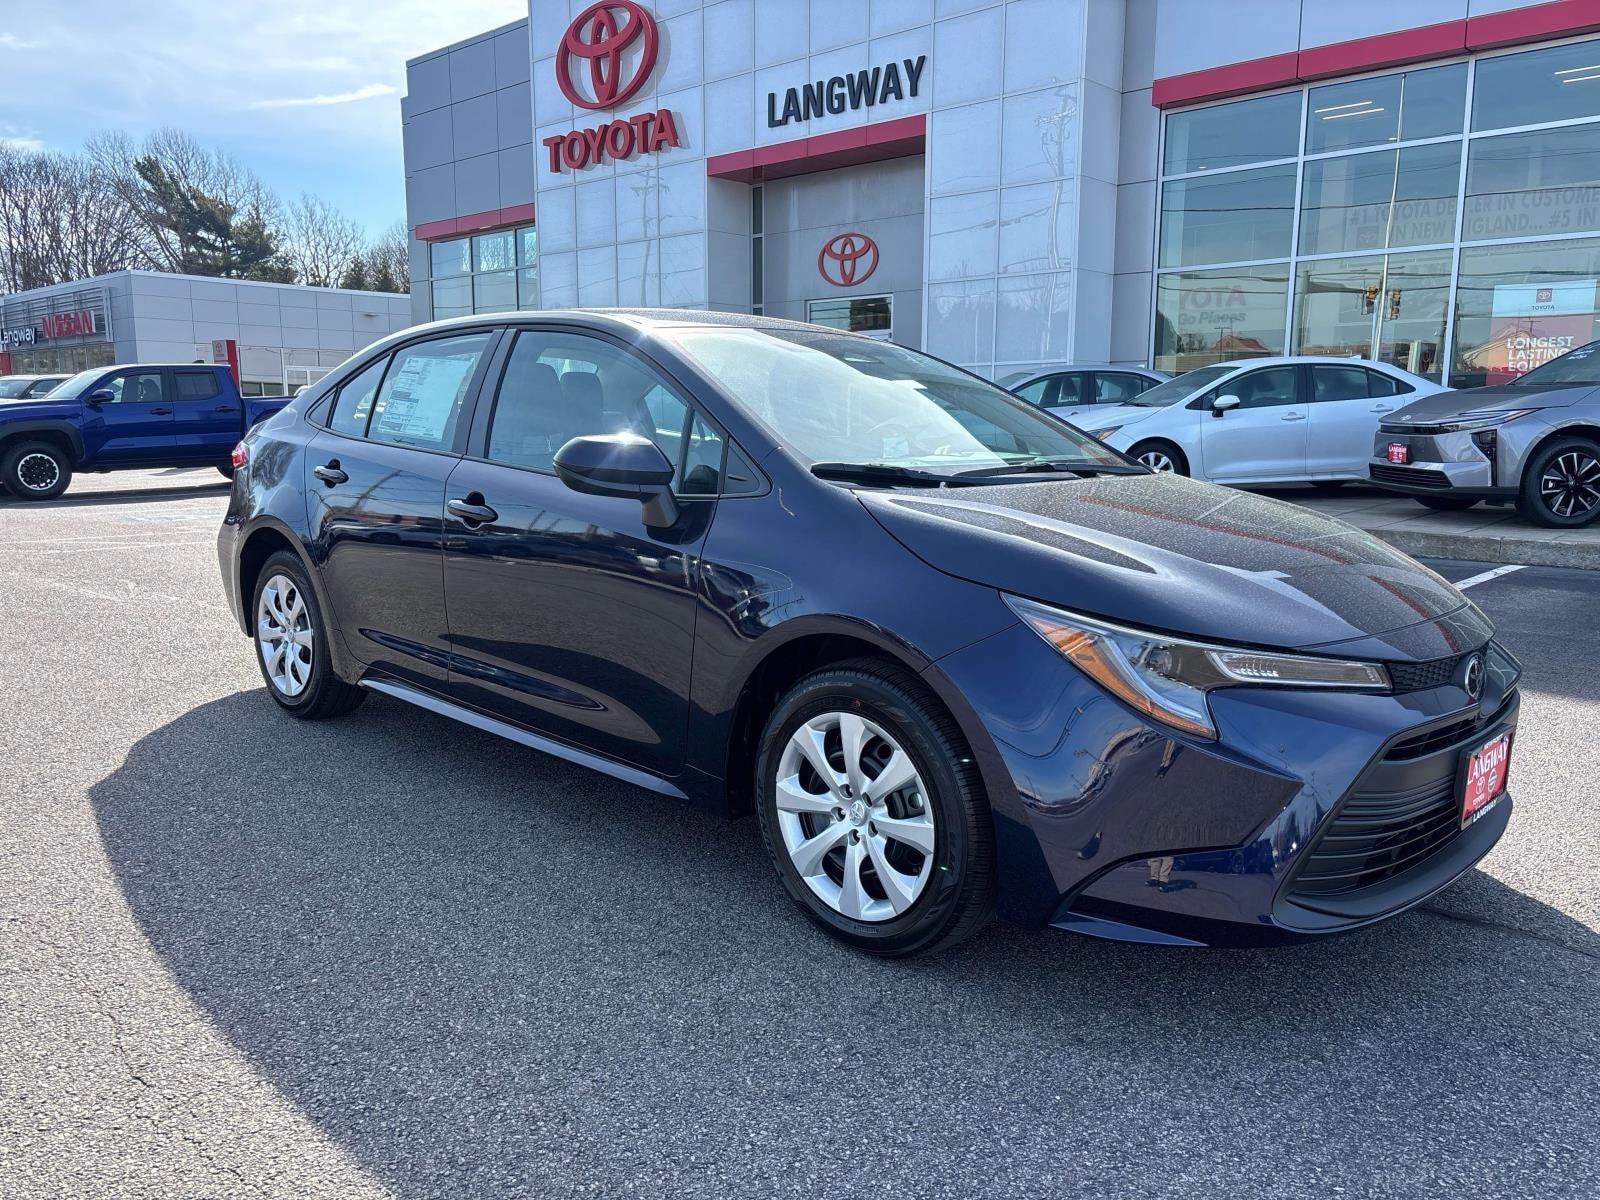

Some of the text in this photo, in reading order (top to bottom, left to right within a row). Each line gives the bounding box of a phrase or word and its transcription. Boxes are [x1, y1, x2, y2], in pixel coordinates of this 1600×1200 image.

[767, 55, 926, 128] LANGWAY
[543, 108, 679, 173] TOYOTA
[1497, 194, 1515, 211] IN
[1577, 206, 1596, 226] IN
[42, 309, 96, 338] NISSAN
[0, 327, 36, 347] Langway
[1507, 336, 1575, 349] LONGEST
[1467, 736, 1510, 785] LANGWAY
